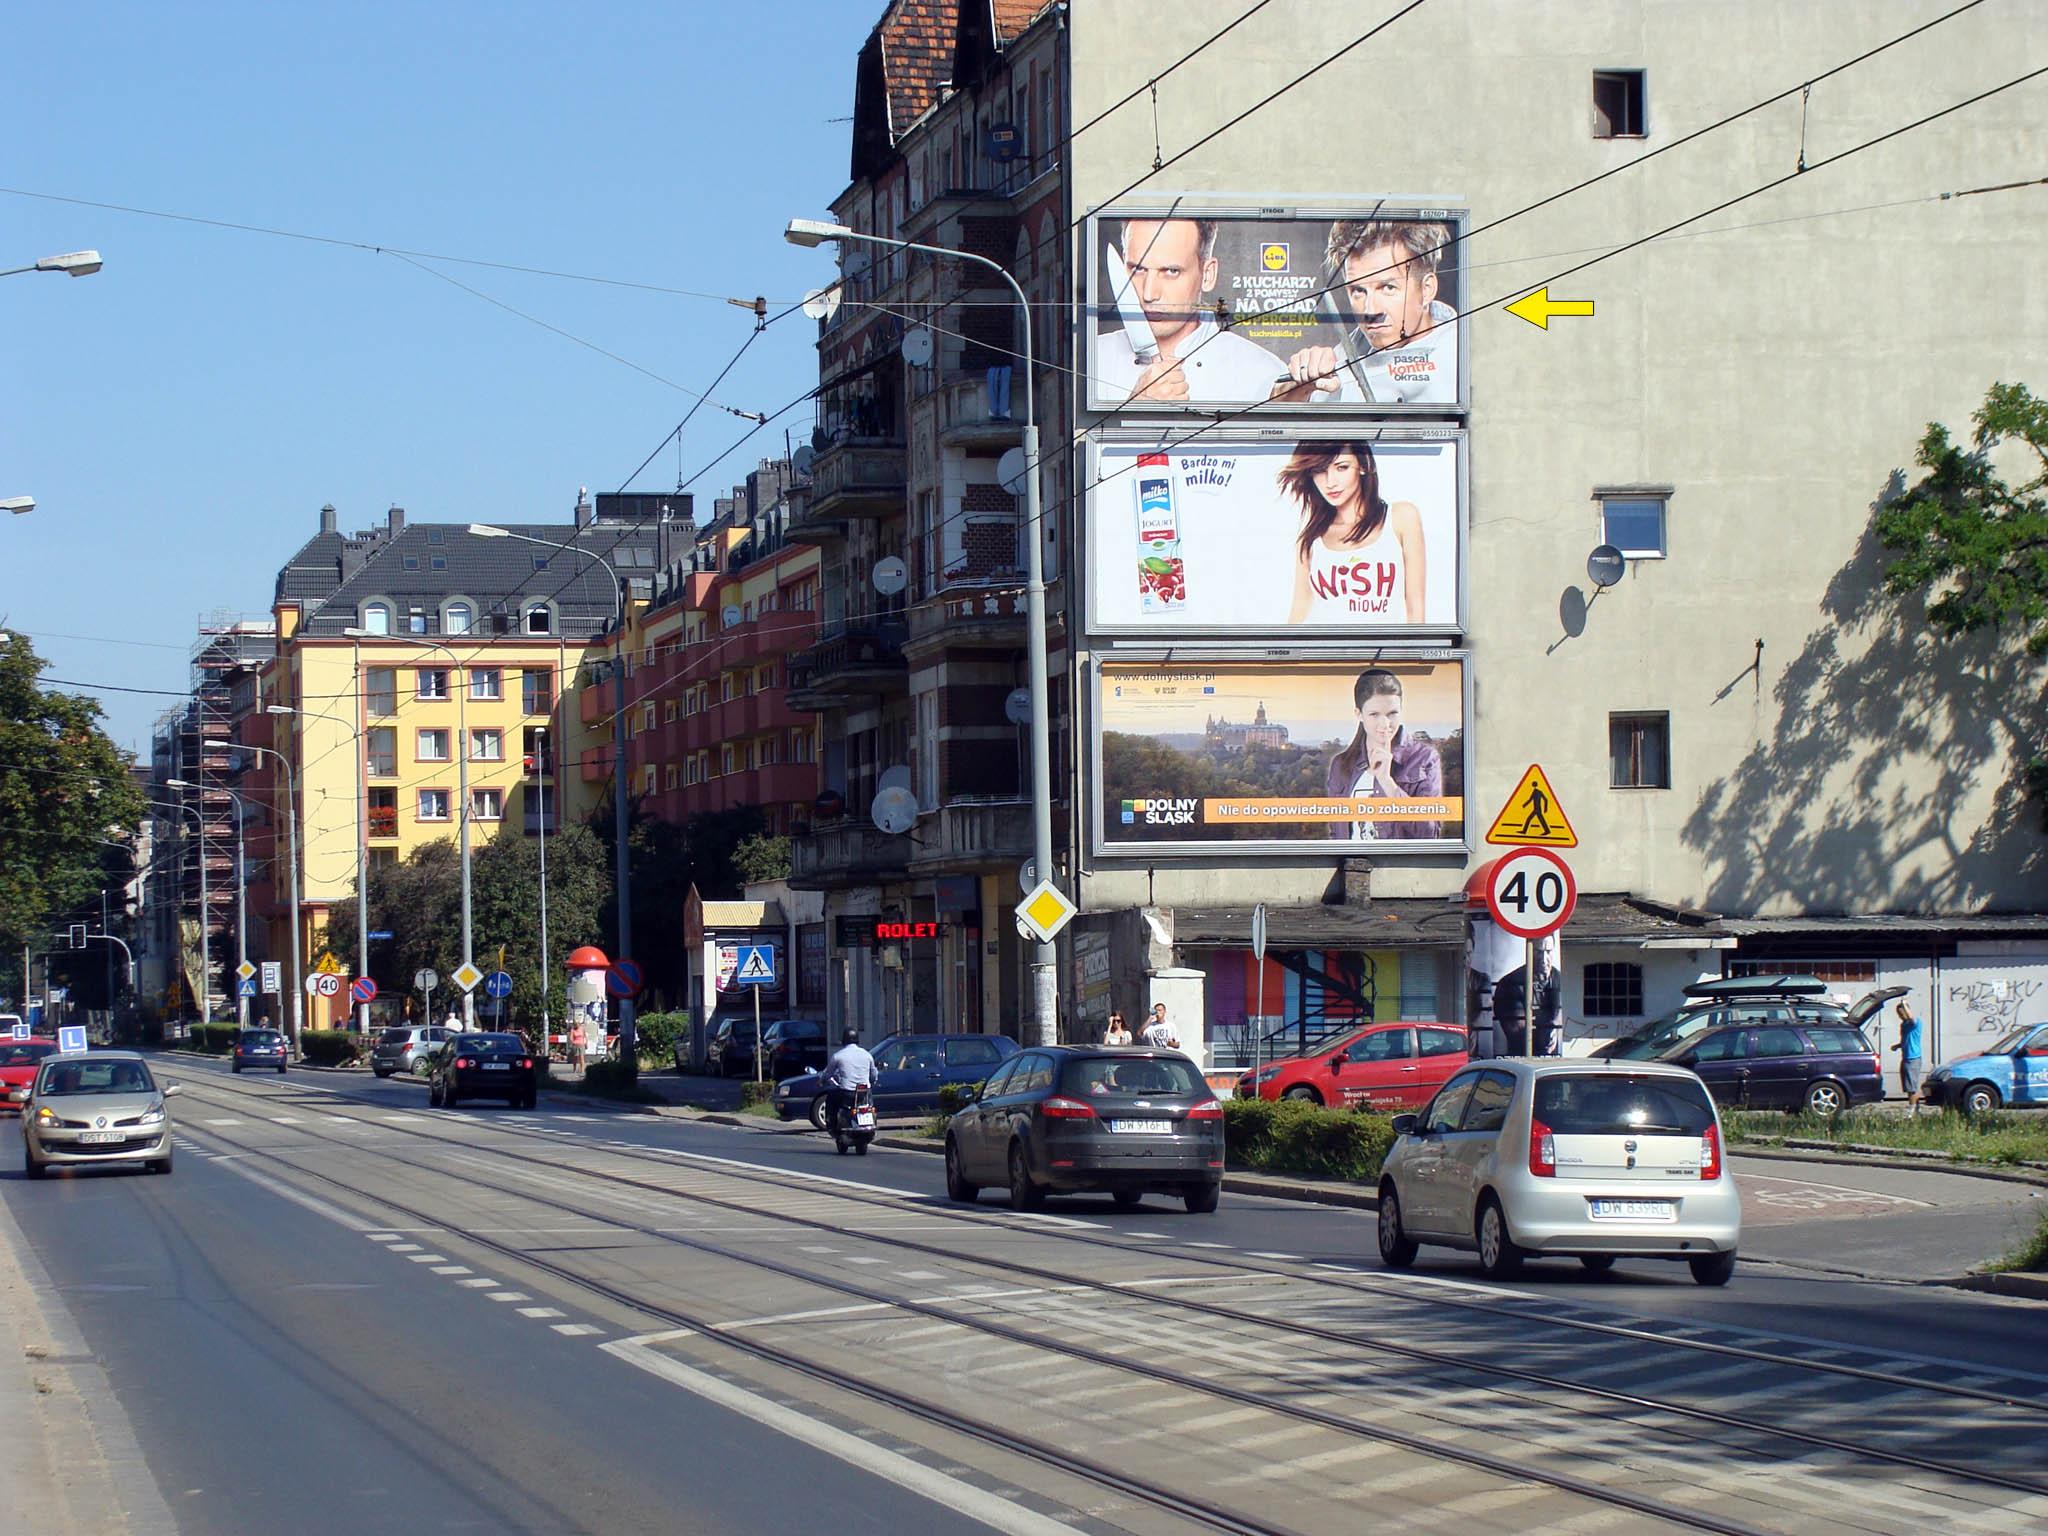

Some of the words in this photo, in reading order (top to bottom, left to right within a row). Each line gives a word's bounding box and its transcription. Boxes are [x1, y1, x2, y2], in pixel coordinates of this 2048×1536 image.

[1232, 276, 1241, 289] 2
[1243, 276, 1317, 289] KUCHARZY
[1246, 288, 1253, 298] 2
[1235, 298, 1260, 313] NA
[1394, 353, 1429, 365] pascal
[1388, 361, 1436, 376] kontra
[1394, 374, 1430, 382] okrasa
[1181, 454, 1218, 470] Bardzo
[1221, 458, 1237, 470] mi
[1186, 469, 1232, 487] milko!
[1349, 598, 1388, 613] niowe
[1146, 799, 1198, 811] DOLNY
[1218, 804, 1239, 816] Nie
[1243, 804, 1259, 816] do
[1263, 804, 1353, 818] opowiedzenia.
[1357, 804, 1375, 815] Do
[1378, 803, 1450, 814] zobaczenia.
[1500, 871, 1563, 913] 40
[320, 979, 338, 991] 40
[18, 1028, 26, 1037] L
[68, 1031, 80, 1047] L
